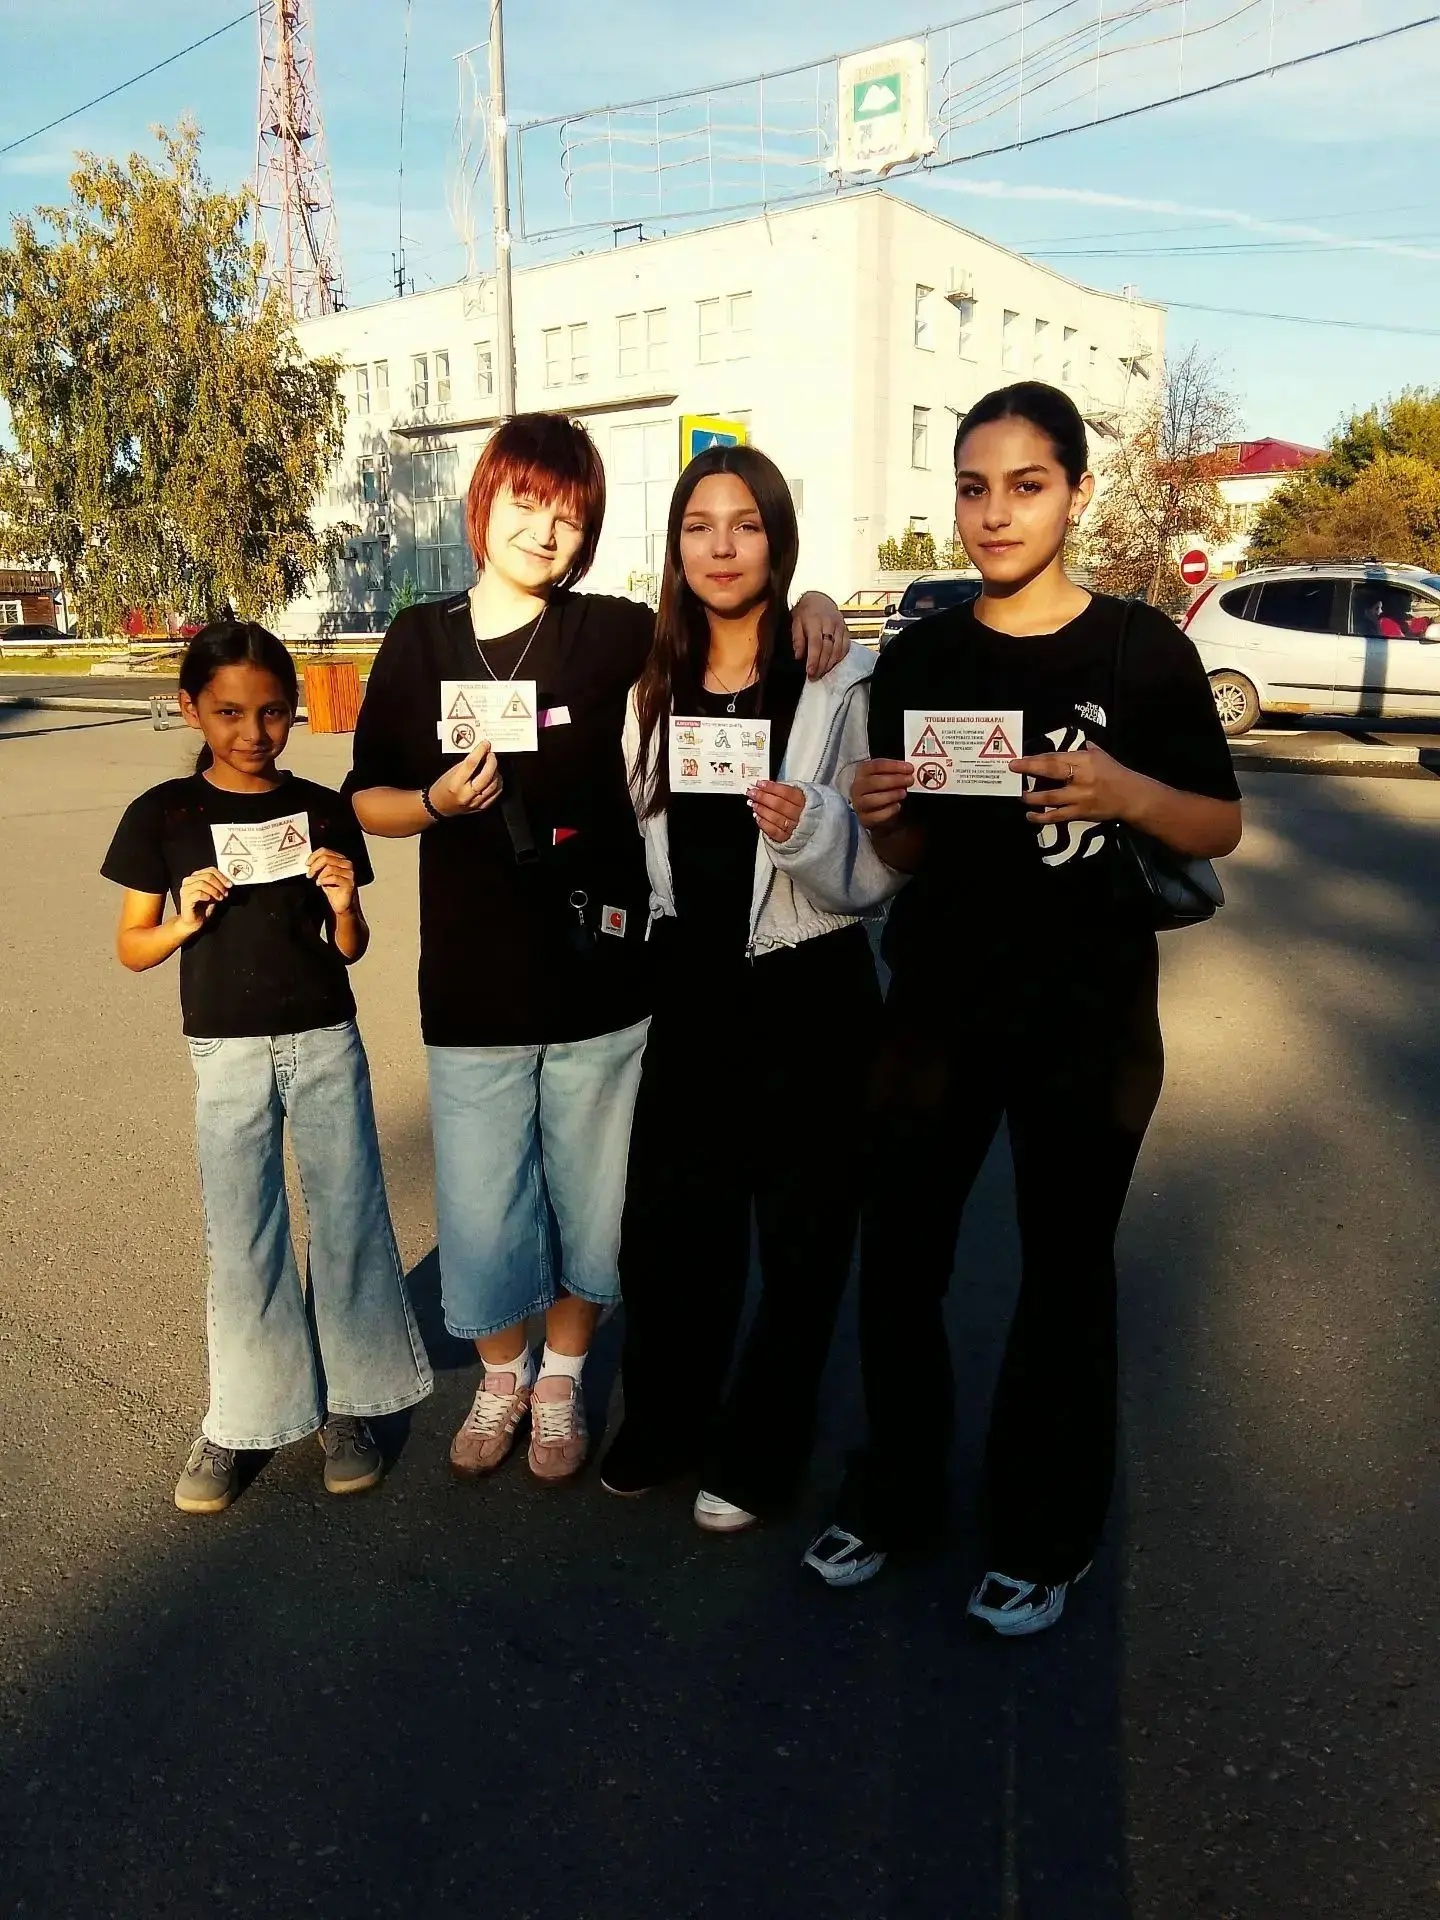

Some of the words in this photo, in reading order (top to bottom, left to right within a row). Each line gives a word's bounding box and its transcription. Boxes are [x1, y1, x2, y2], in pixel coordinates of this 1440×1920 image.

[1074, 703, 1098, 717] NORTH
[1086, 701, 1098, 710] THE
[1080, 710, 1099, 724] FACE
